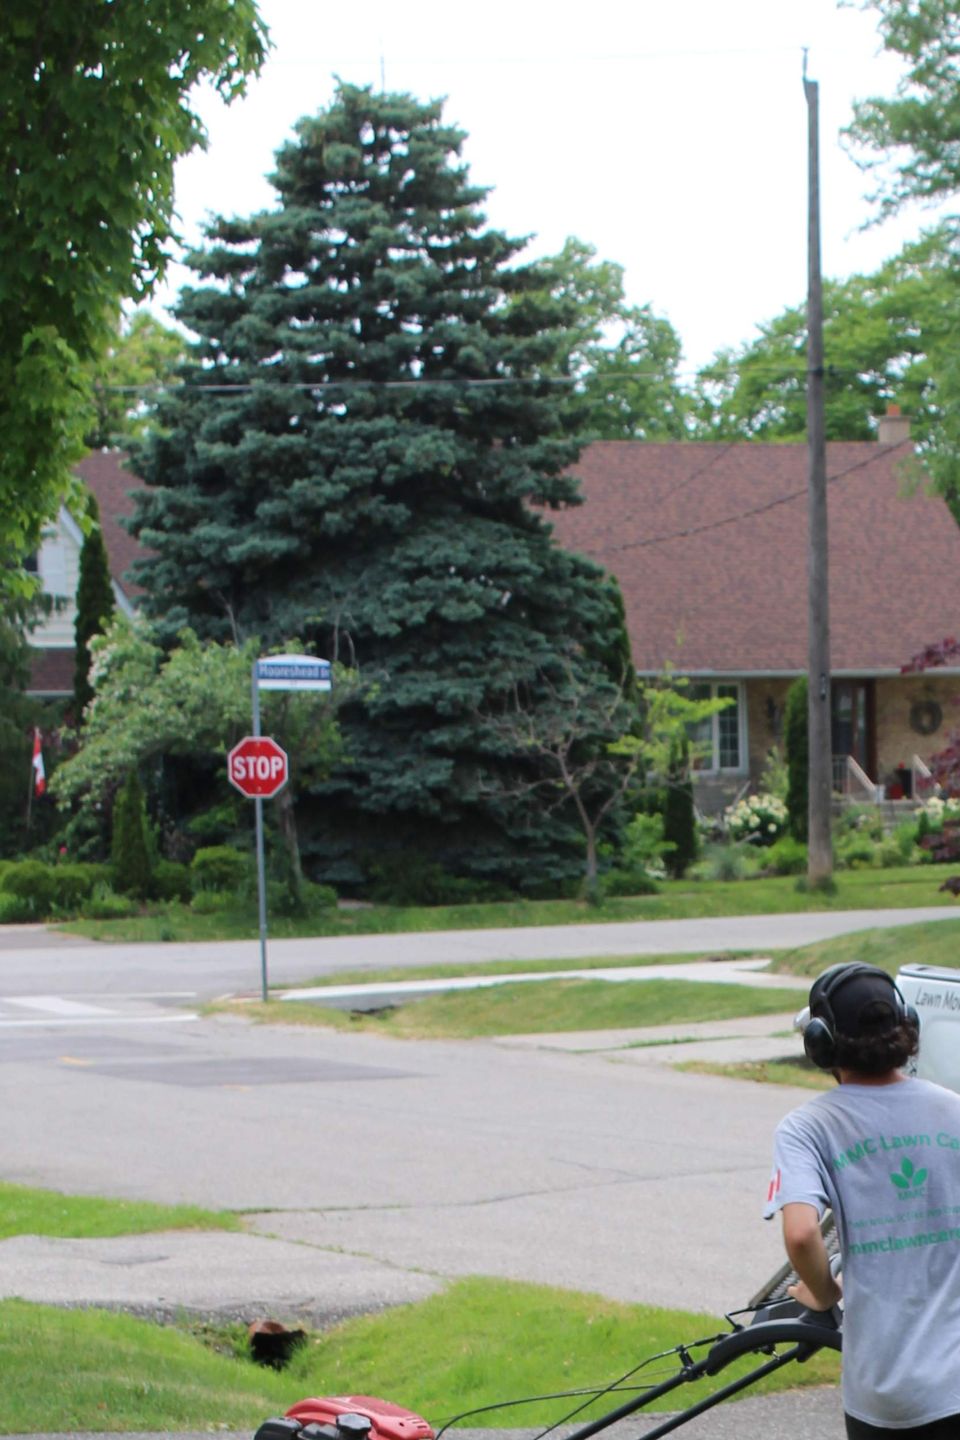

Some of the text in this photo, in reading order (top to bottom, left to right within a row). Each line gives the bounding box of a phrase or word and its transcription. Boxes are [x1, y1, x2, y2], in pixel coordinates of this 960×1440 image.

[233, 755, 284, 781] STOP
[915, 988, 942, 1008] Lawn
[832, 1137, 877, 1171] MMC
[880, 1134, 931, 1151] Lawn
